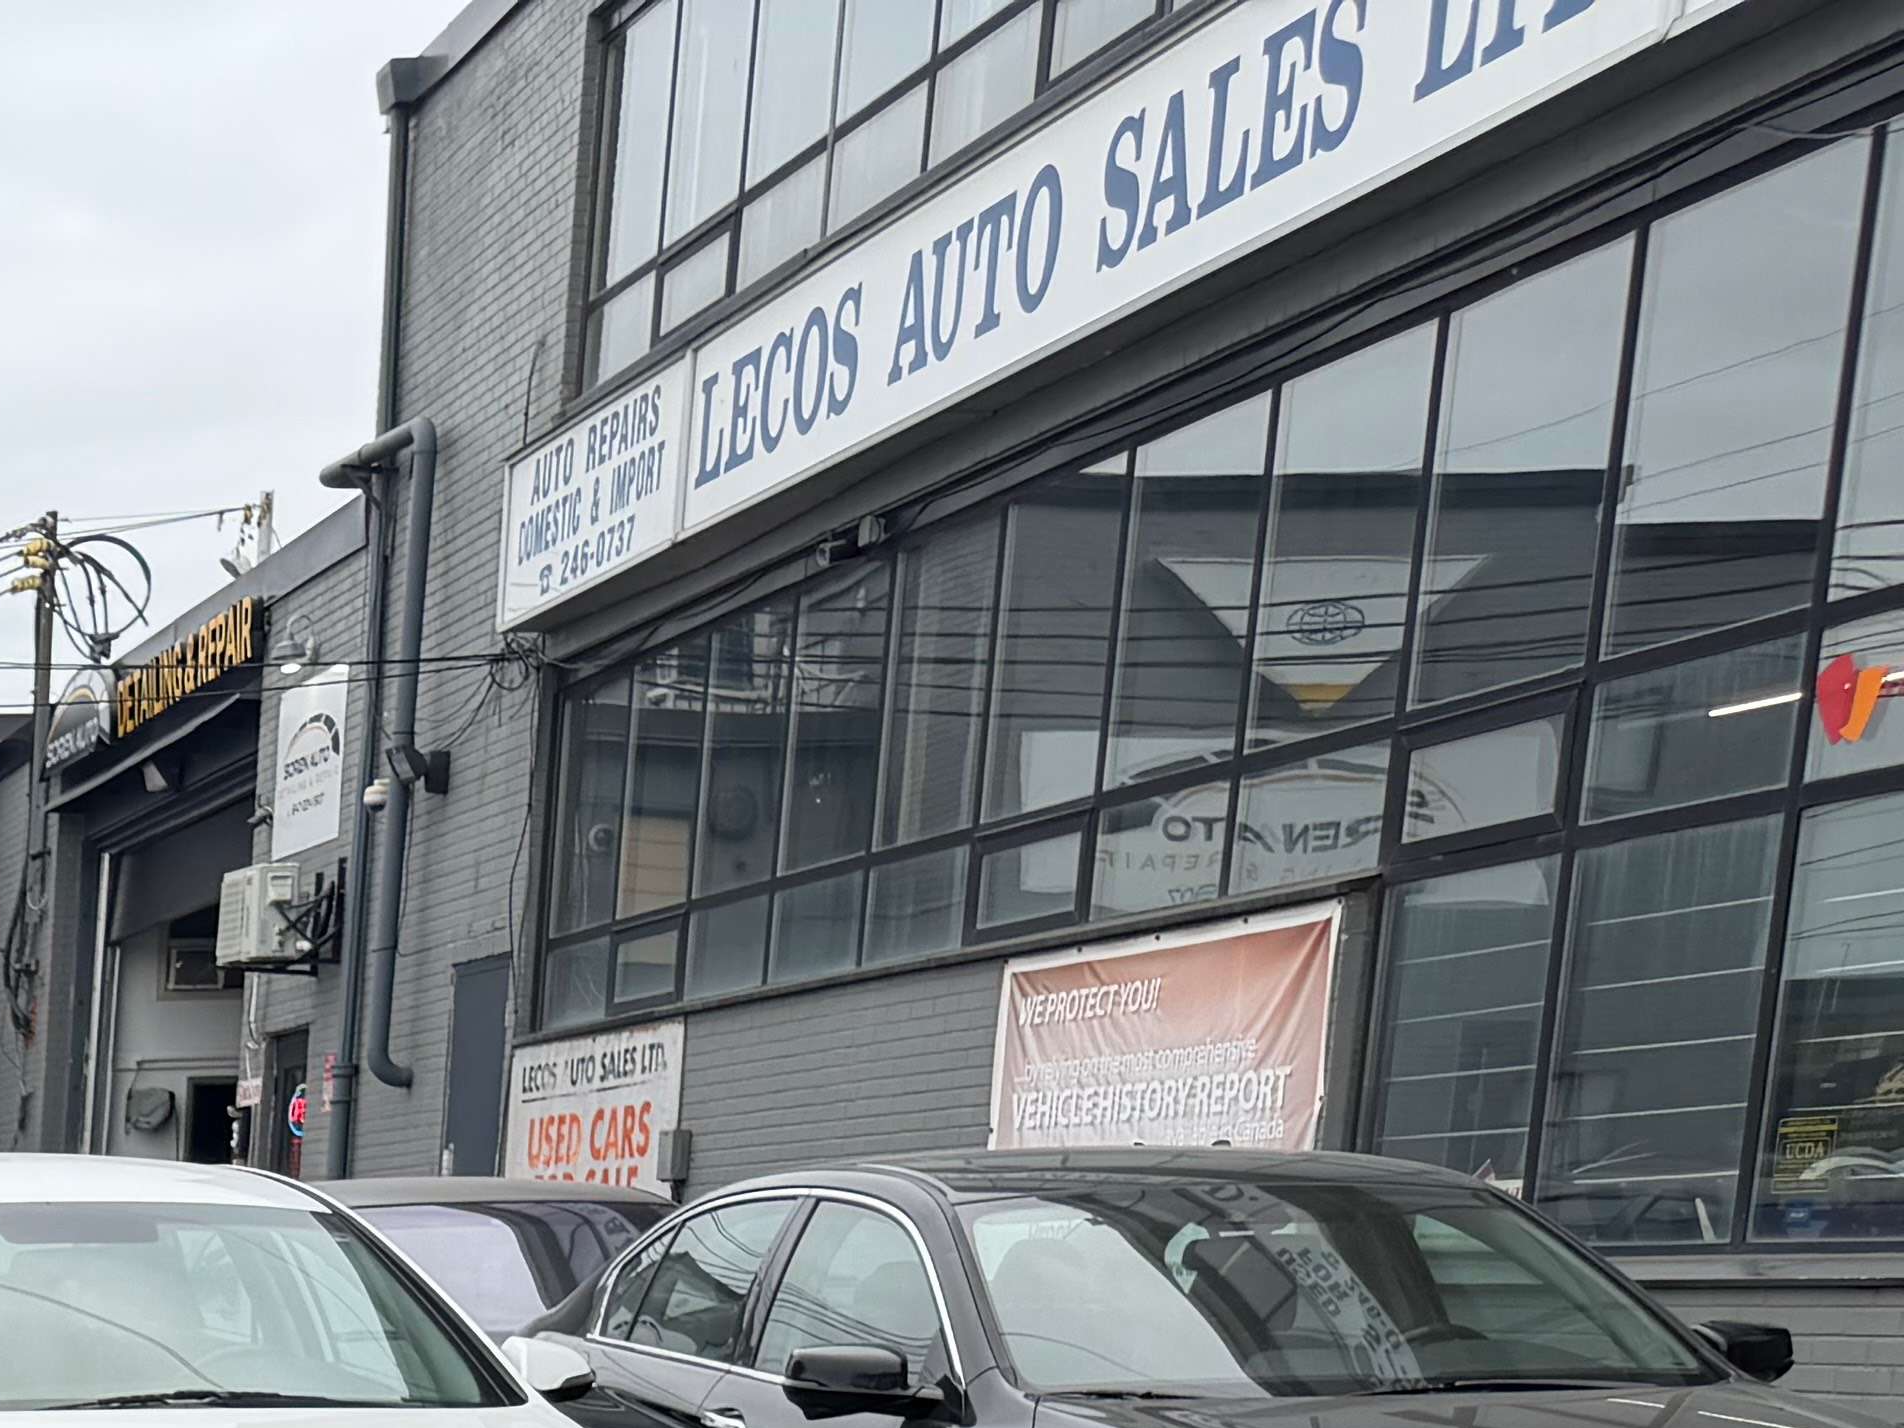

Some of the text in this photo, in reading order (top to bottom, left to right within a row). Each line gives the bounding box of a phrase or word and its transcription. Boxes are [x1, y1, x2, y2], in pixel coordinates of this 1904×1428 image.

[694, 281, 863, 490] LECOS
[887, 163, 1064, 387] AUTO
[1095, 0, 1368, 274] SALES
[530, 384, 661, 506] AUTO REPAIRS
[518, 440, 666, 566] DOMESTIC & IMPORT
[559, 514, 636, 586] 246-0737
[116, 596, 253, 738] DETAILING & REPAIR
[1018, 977, 1162, 1027] WE PROTECT YOU!
[562, 1054, 596, 1087] UTO
[600, 1046, 637, 1083] SALES
[1012, 1065, 1293, 1129] VEHICLE HISTORY REPORT
[527, 1100, 652, 1169] USED CARS
